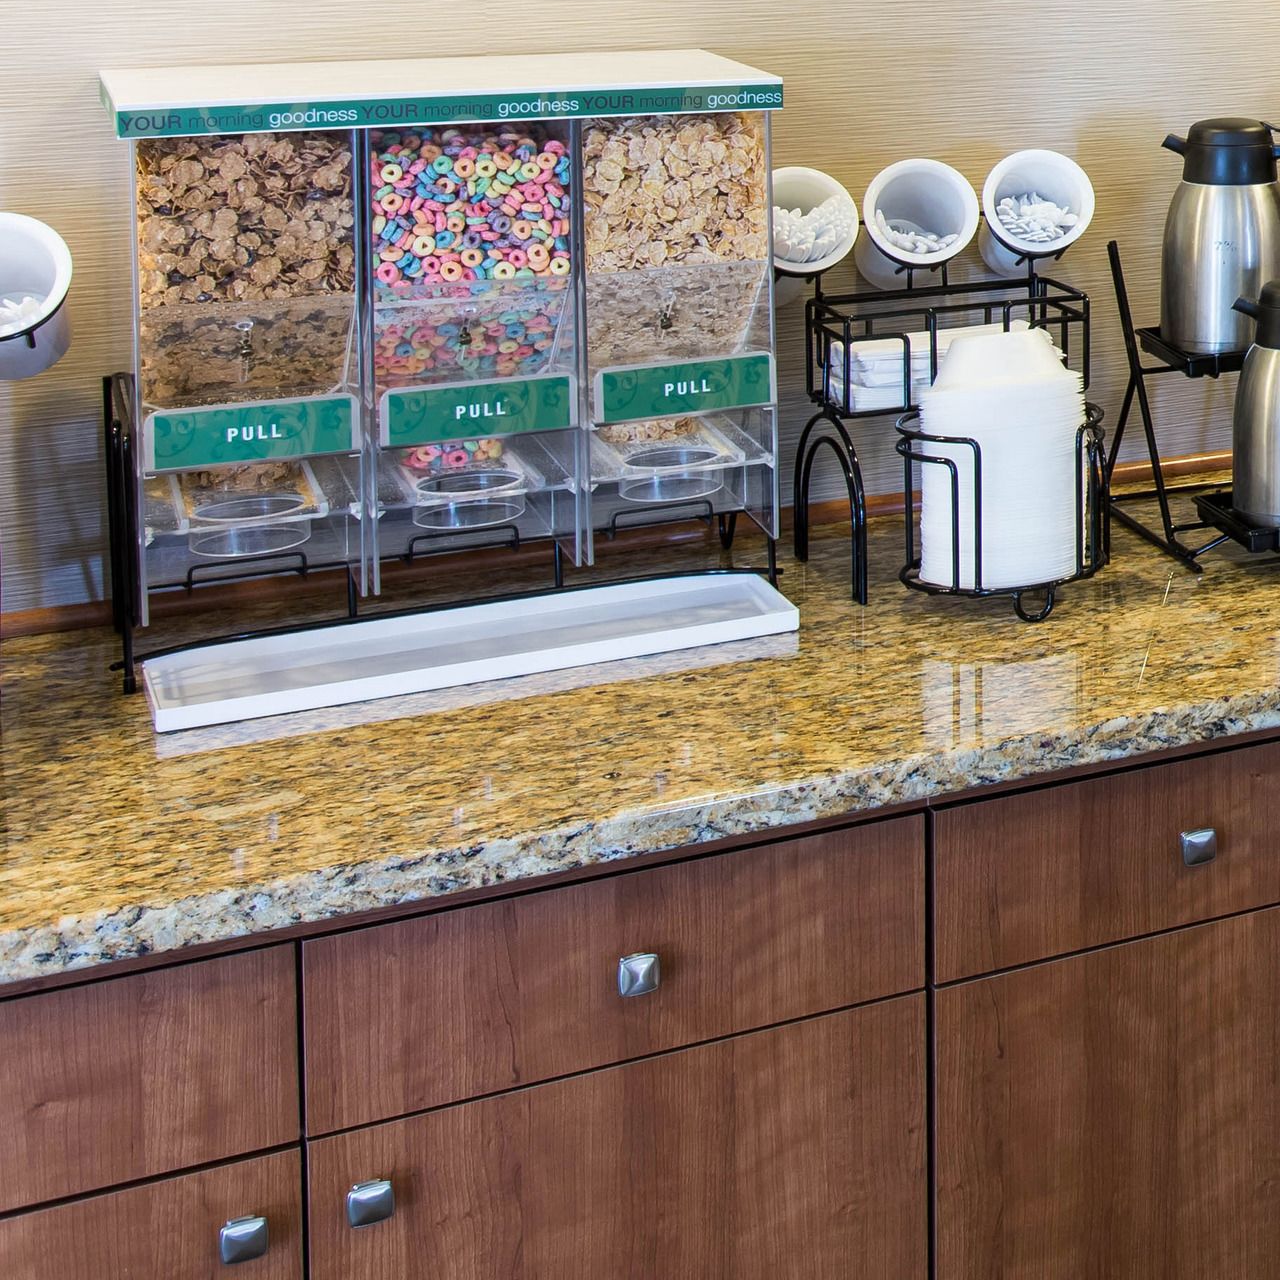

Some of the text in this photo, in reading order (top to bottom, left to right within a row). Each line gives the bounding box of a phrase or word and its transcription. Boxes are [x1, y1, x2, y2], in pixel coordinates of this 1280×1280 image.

[121, 90, 782, 132] YOUR morning goodness YOUR morning goodness YOUR morning goodness
[664, 379, 711, 397] PULL
[455, 401, 507, 420] PULL
[227, 423, 283, 443] PULL
